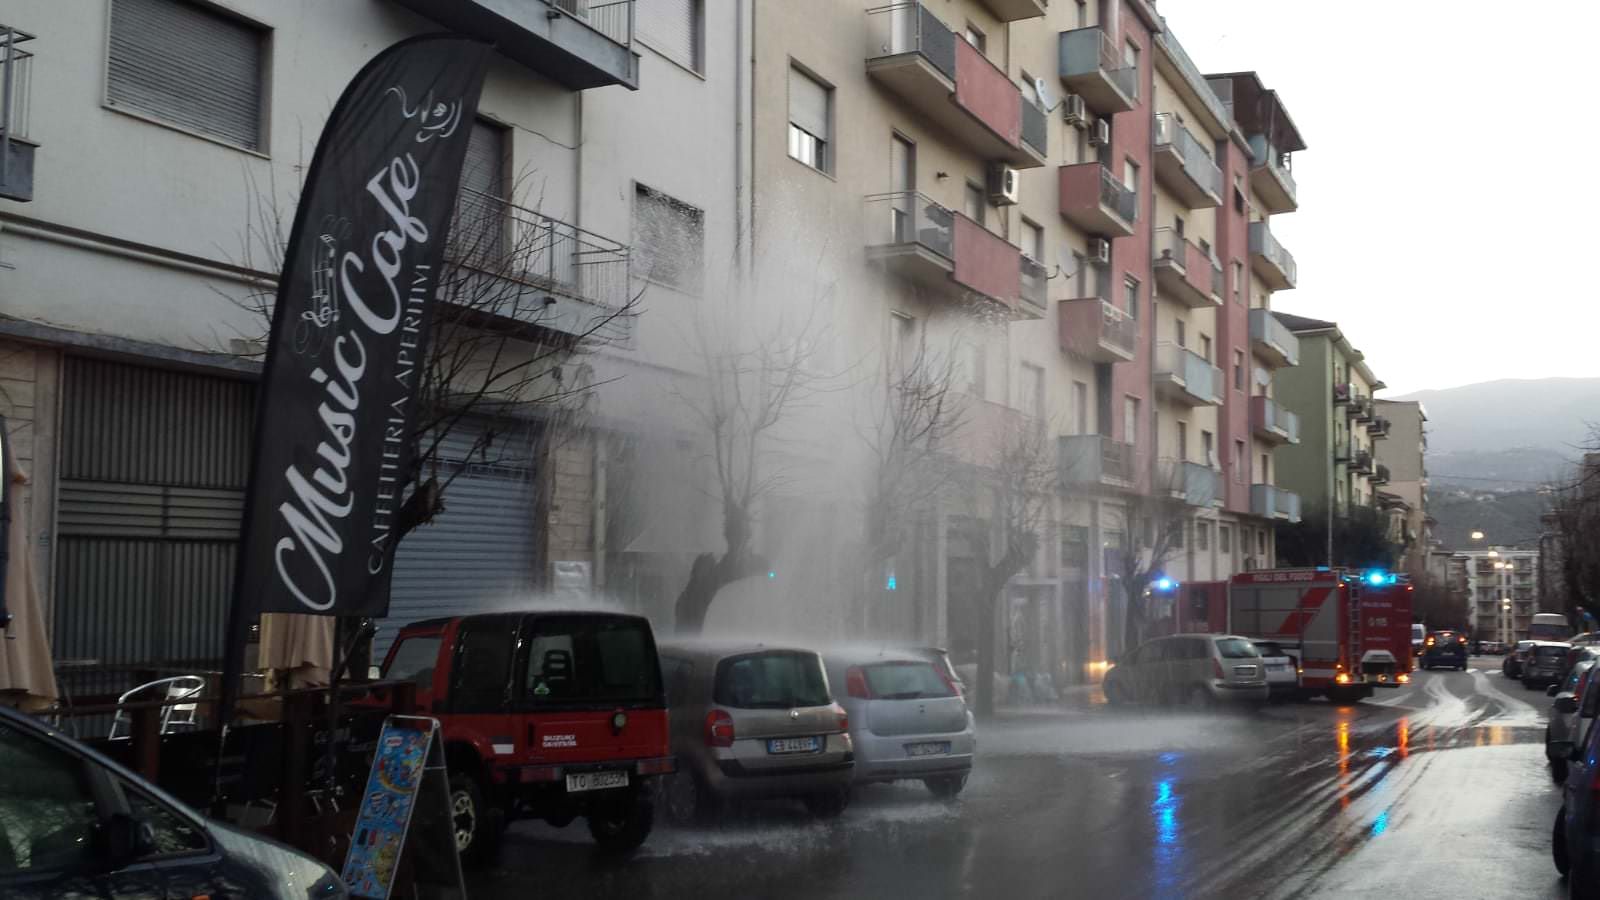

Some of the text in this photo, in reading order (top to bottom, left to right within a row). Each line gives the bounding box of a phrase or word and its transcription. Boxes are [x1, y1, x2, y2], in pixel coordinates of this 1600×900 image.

[274, 329, 366, 612] Music
[367, 264, 431, 575] CAFFETTERIA APERITIVI
